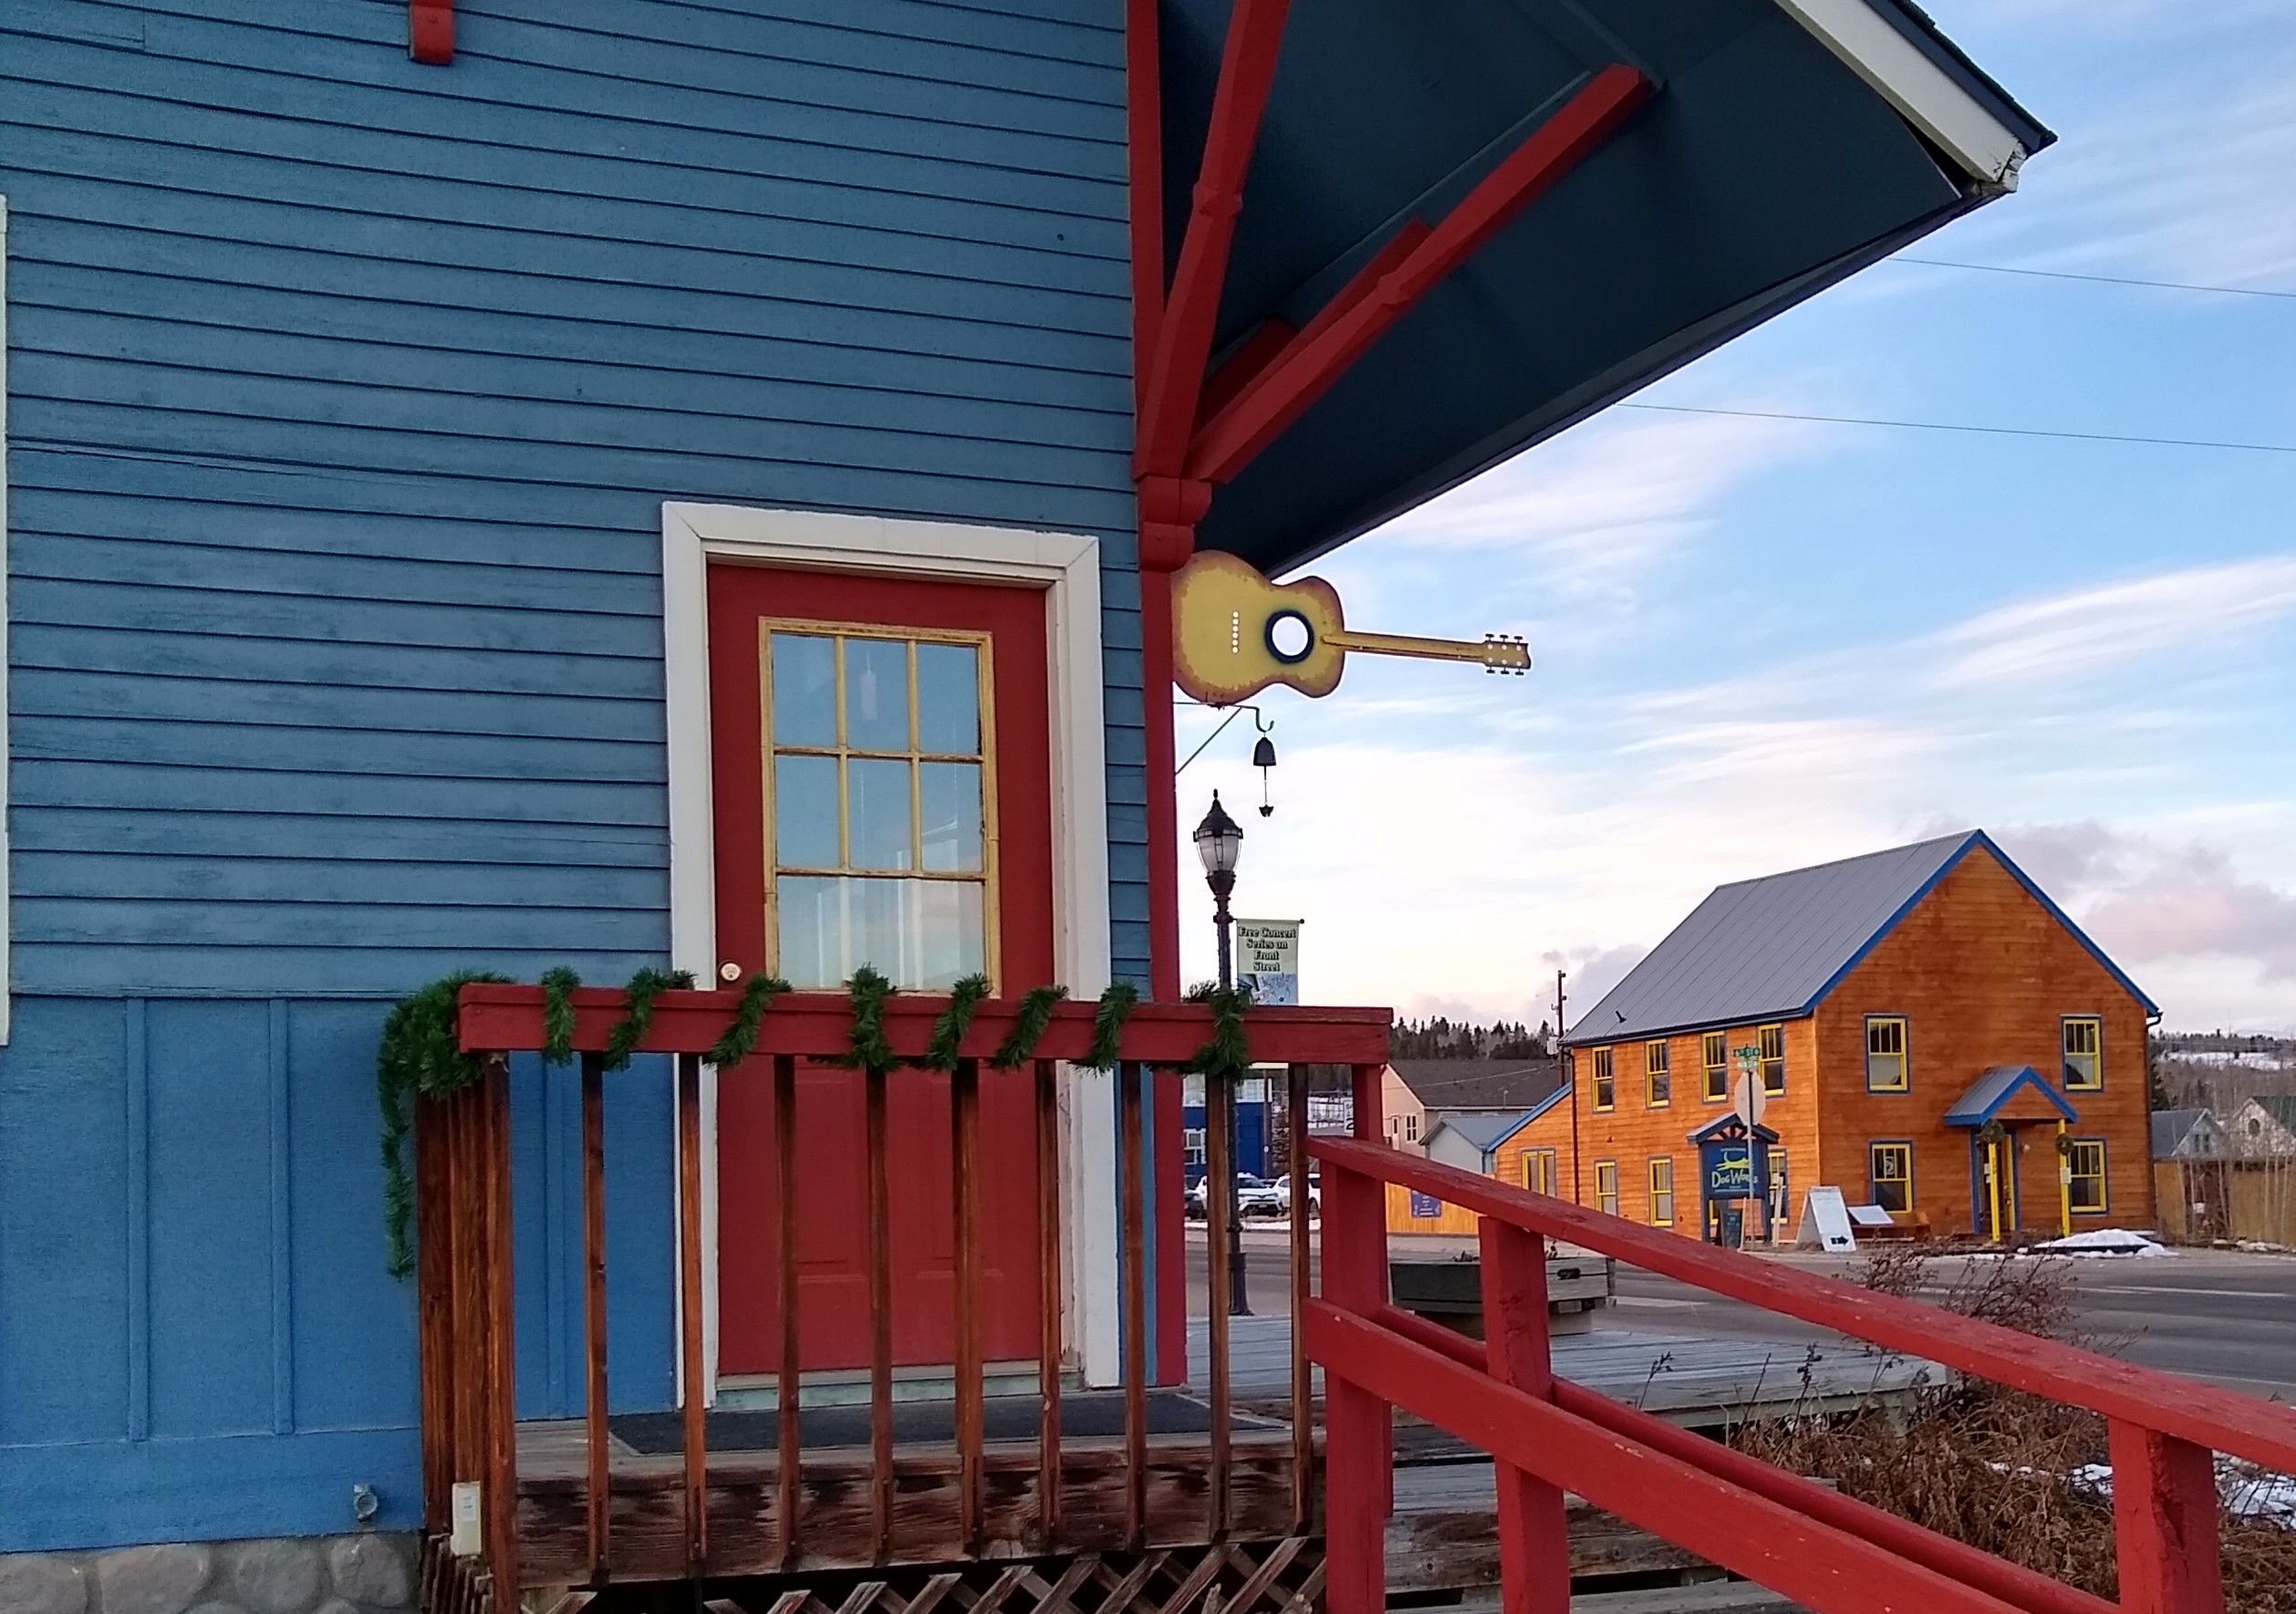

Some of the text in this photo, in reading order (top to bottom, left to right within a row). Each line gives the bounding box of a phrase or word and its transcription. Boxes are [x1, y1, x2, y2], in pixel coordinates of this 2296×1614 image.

[1238, 927, 1296, 938] Free Concert
[1246, 939, 1274, 949] Series
[1253, 951, 1280, 960] Front
[1253, 962, 1281, 972] Street
